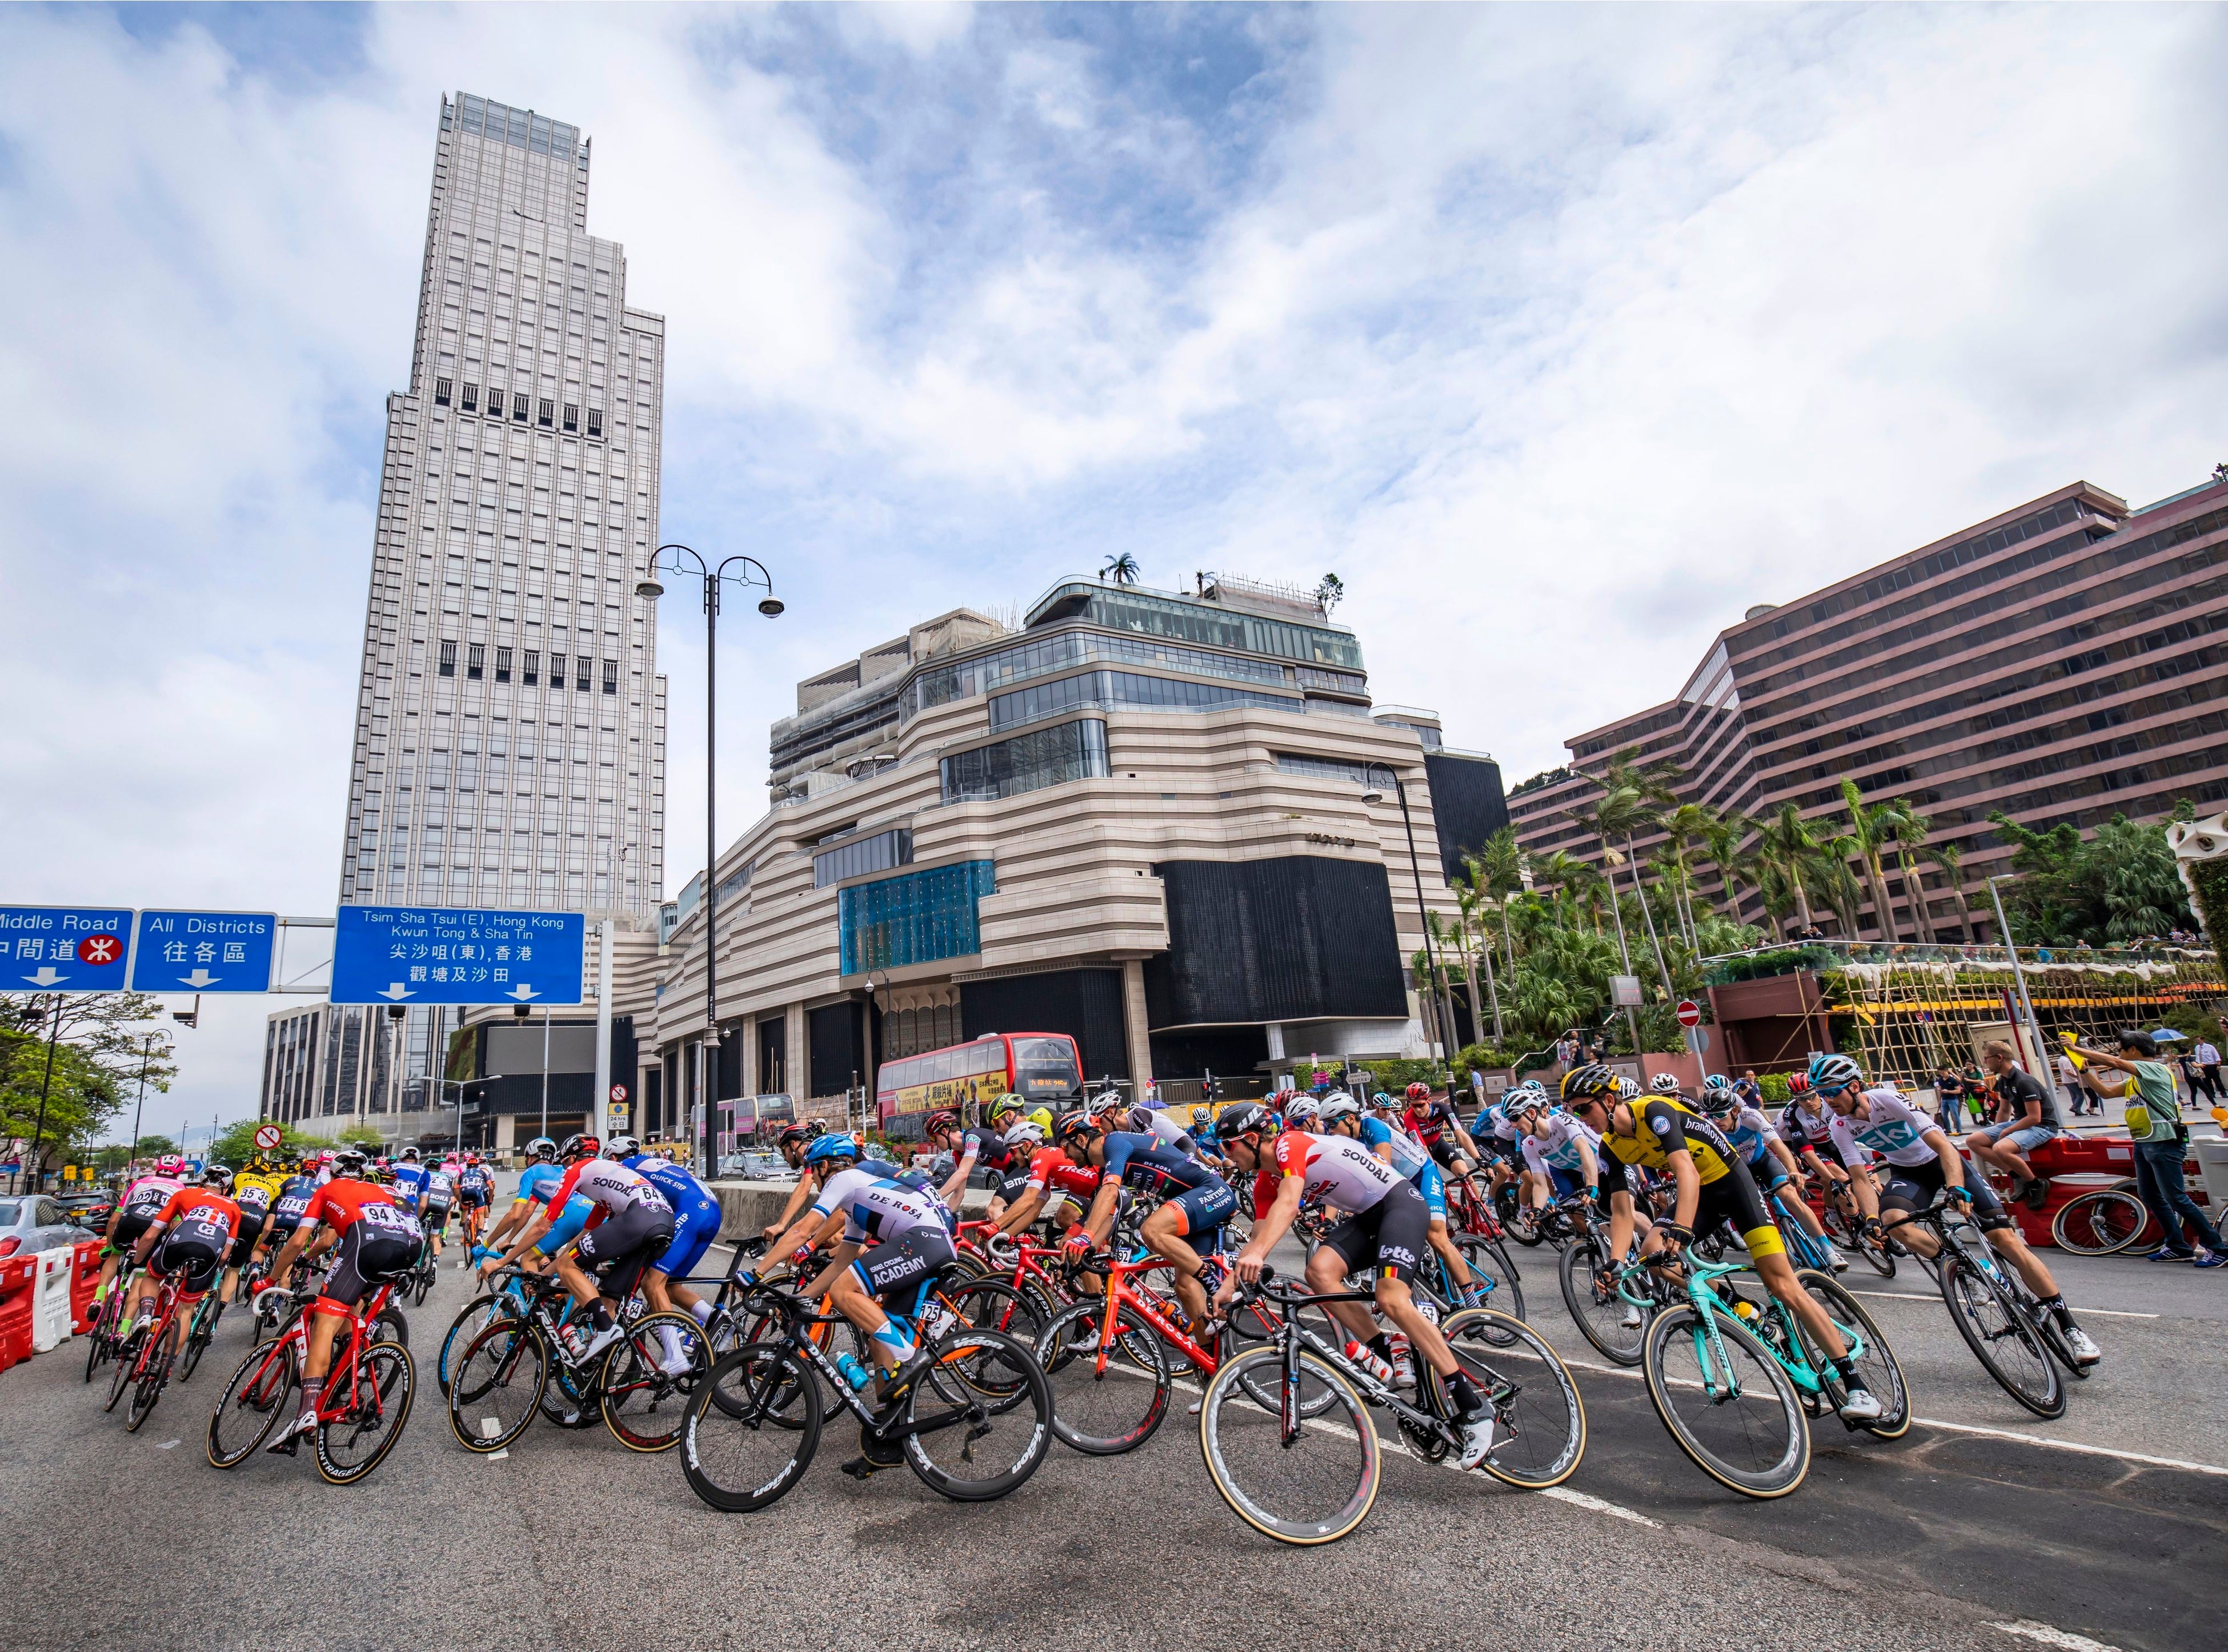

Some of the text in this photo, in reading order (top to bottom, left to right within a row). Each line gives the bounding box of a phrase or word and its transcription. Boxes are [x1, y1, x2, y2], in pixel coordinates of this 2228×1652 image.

[63, 915, 118, 931] Road
[149, 917, 266, 935] All Districts
[362, 911, 564, 929] Tsim Sha Tsui (E), Hong Kong
[391, 927, 533, 940] Kwun Tong & Sha Tin
[163, 940, 246, 963] 往各區
[409, 966, 509, 983] 觀塘及沙田
[1681, 1096, 1699, 1108] GIANT
[1132, 1113, 1143, 1125] GIANT
[1237, 1106, 1263, 1132] HJC
[1784, 1105, 1794, 1118] UAE
[1060, 1114, 1085, 1129] Kabuto
[1810, 1115, 1832, 1130] UAE
[1685, 1117, 1731, 1157] brandloyalty
[1342, 1148, 1391, 1184] SOUDAL
[1503, 1154, 1514, 1166] sky
[661, 1168, 683, 1178] latexco
[1057, 1165, 1097, 1179] TREK
[1154, 1164, 1171, 1173] ROSA
[394, 1181, 402, 1190] 14
[592, 1177, 634, 1197] SOUDAL
[650, 1173, 687, 1191] QUICK STEP
[1004, 1173, 1030, 1189] BMC
[1430, 1174, 1441, 1197] HKT
[241, 1189, 255, 1198] 35
[258, 1191, 270, 1205] 35
[430, 1193, 448, 1202] BORA
[642, 1187, 659, 1200] 64
[1066, 1194, 1084, 1206] jayco
[1198, 1186, 1227, 1205] FANTINI
[135, 1205, 161, 1216] EF
[280, 1199, 293, 1208] 81
[326, 1201, 347, 1219] TREK
[869, 1193, 890, 1204] DE
[892, 1201, 923, 1220] ROSA
[1213, 1195, 1232, 1210] NIPPO
[189, 1208, 209, 1217] 95
[368, 1208, 389, 1222] 94
[672, 1229, 684, 1242] FLOORS
[869, 1256, 904, 1273] ISRAEL CYCLING
[1118, 1251, 1128, 1262] 92
[1389, 1258, 1413, 1270] RIDLEY
[656, 1262, 671, 1273] latexco
[873, 1256, 927, 1286] ACADEMY
[630, 1304, 639, 1317] 64
[921, 1305, 939, 1320] 125
[1135, 1297, 1194, 1350] DE ROSA
[535, 1312, 578, 1369] RIDLEY
[953, 1336, 1005, 1349] Vision
[441, 1326, 459, 1382] CORIMA
[808, 1345, 826, 1366] DE
[1138, 1328, 1165, 1385] BORA
[362, 1347, 409, 1392] BONTRAGER
[1301, 1329, 1400, 1398] RIDLEY
[215, 1342, 274, 1416] BONTRAGER
[452, 1359, 468, 1411] BORA
[1299, 1360, 1357, 1409] BORA
[1124, 1389, 1165, 1443] ULTRA
[318, 1428, 364, 1477] BONTRAGER
[753, 1458, 797, 1498] Vision
